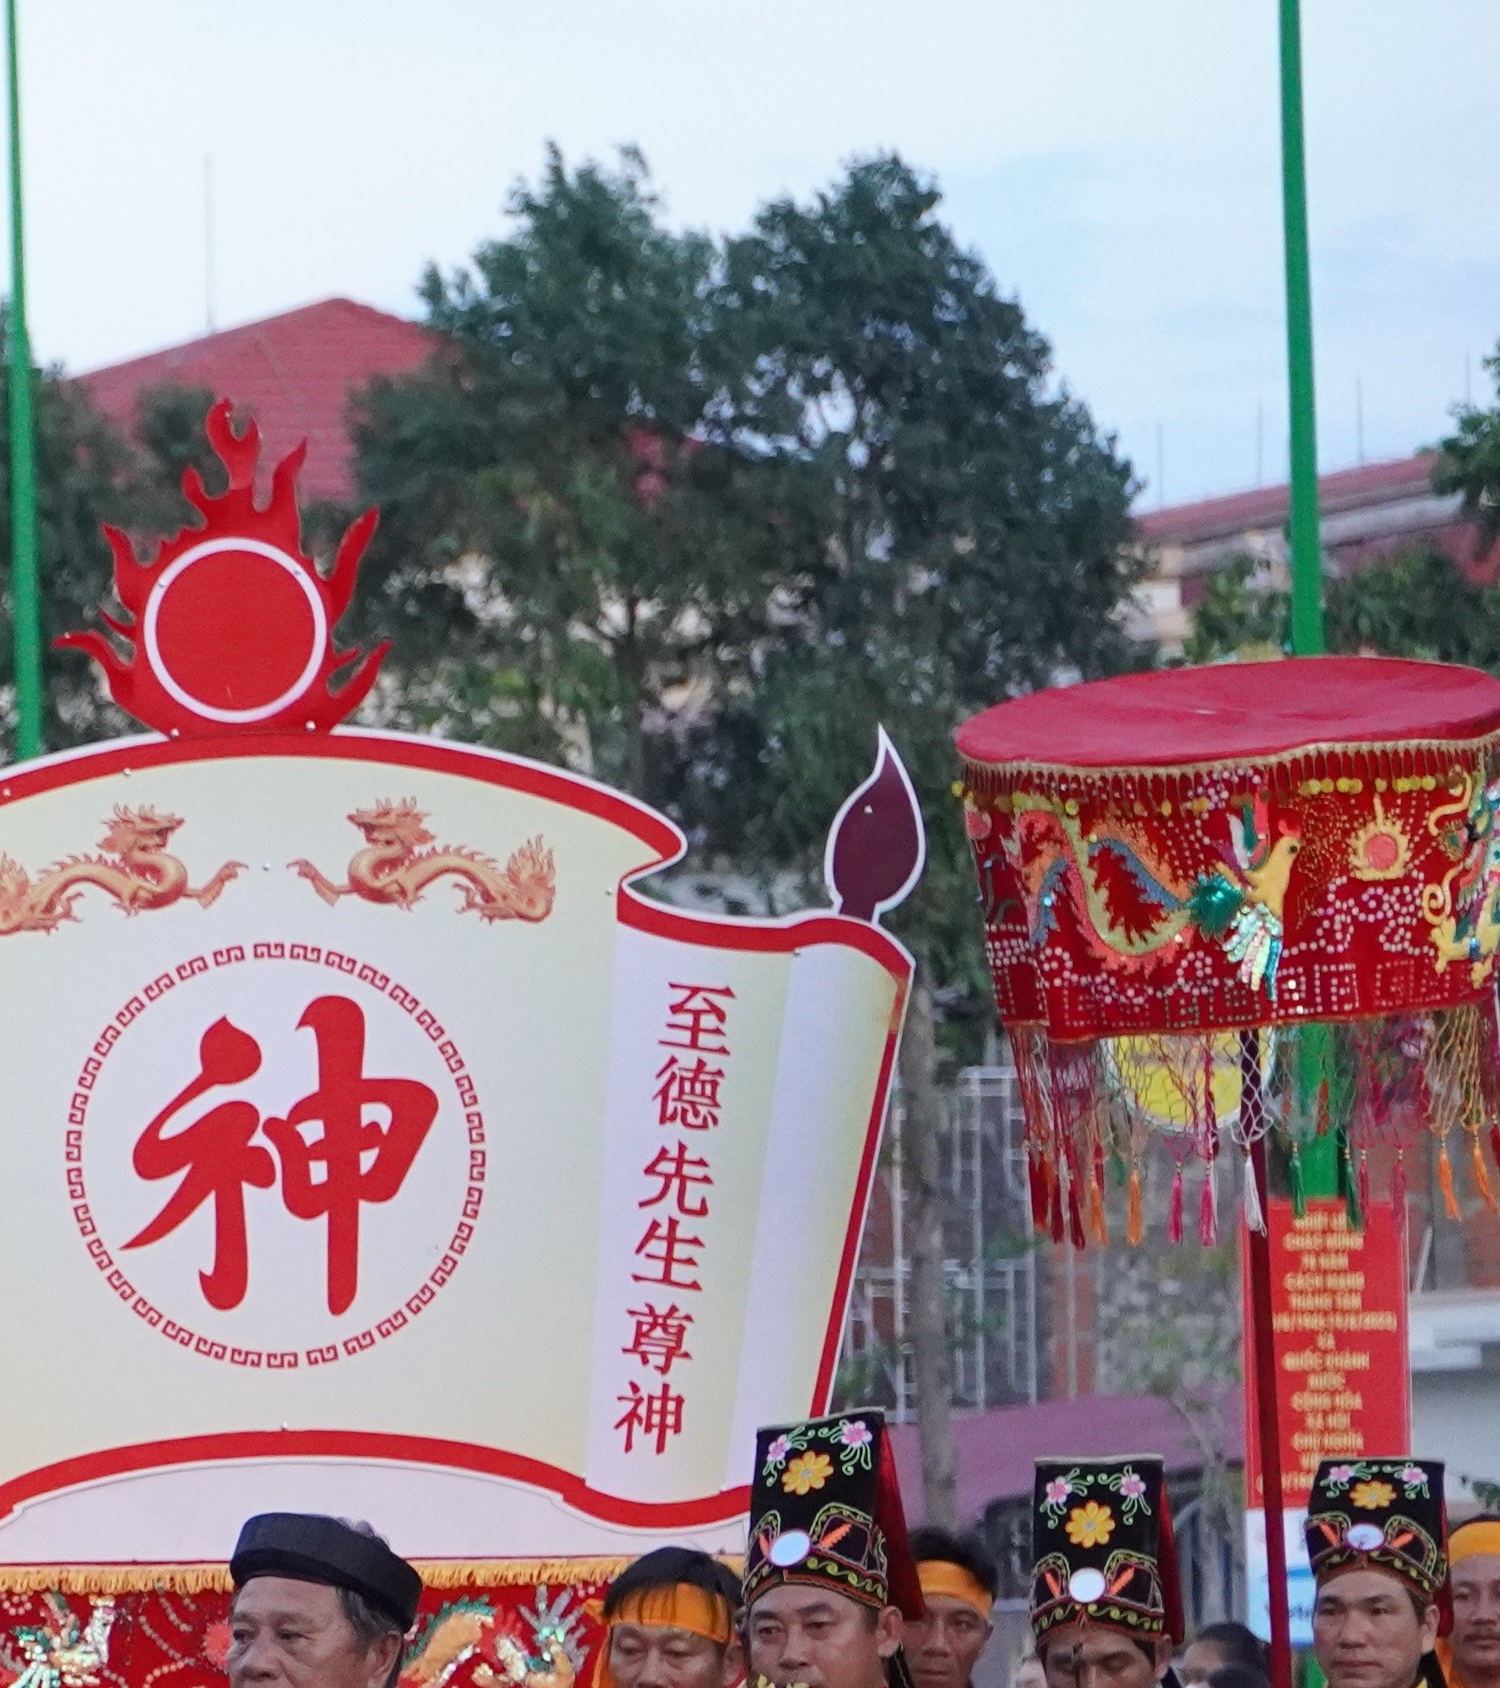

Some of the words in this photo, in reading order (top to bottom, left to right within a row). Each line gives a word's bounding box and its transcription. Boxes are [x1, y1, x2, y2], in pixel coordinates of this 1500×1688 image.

[119, 994, 439, 1316] 神
[614, 980, 736, 1455] 至德先生尊神
